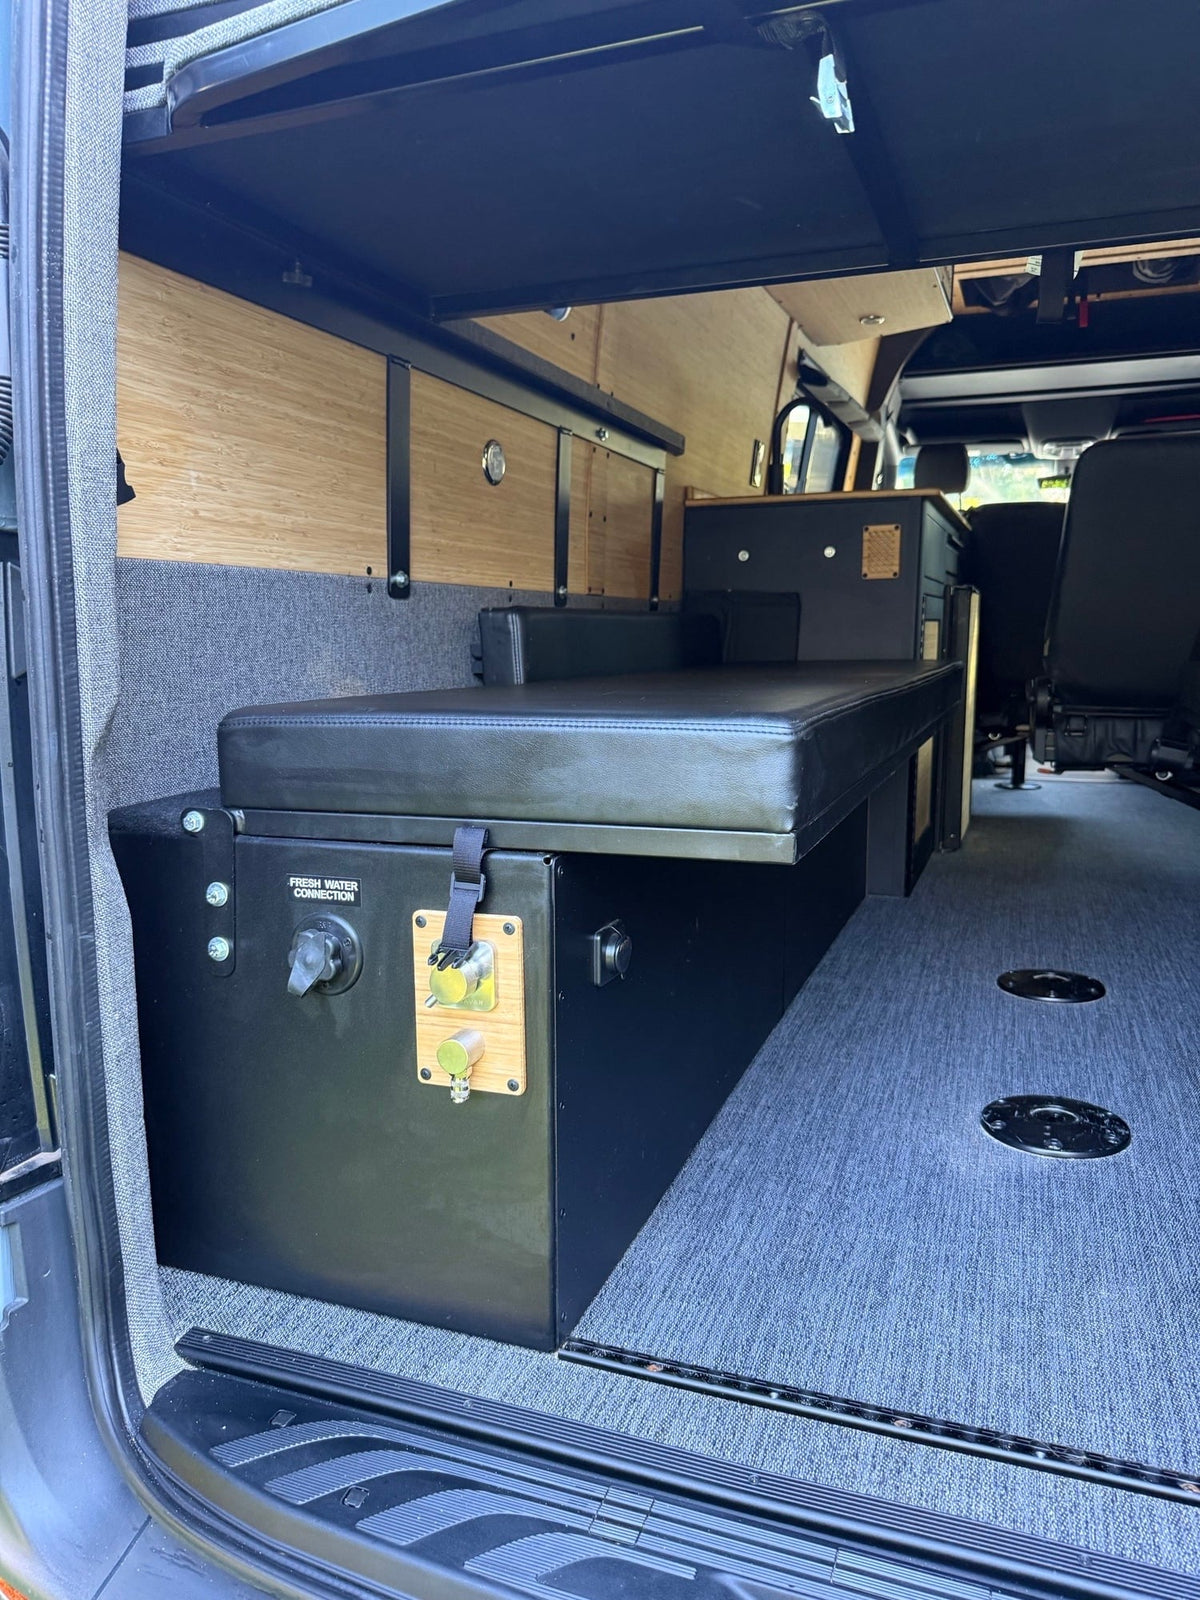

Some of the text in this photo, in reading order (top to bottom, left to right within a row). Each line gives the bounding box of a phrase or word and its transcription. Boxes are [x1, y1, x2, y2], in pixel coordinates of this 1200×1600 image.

[289, 877, 358, 891] FRESH WATER
[293, 888, 354, 901] CONNECTION
